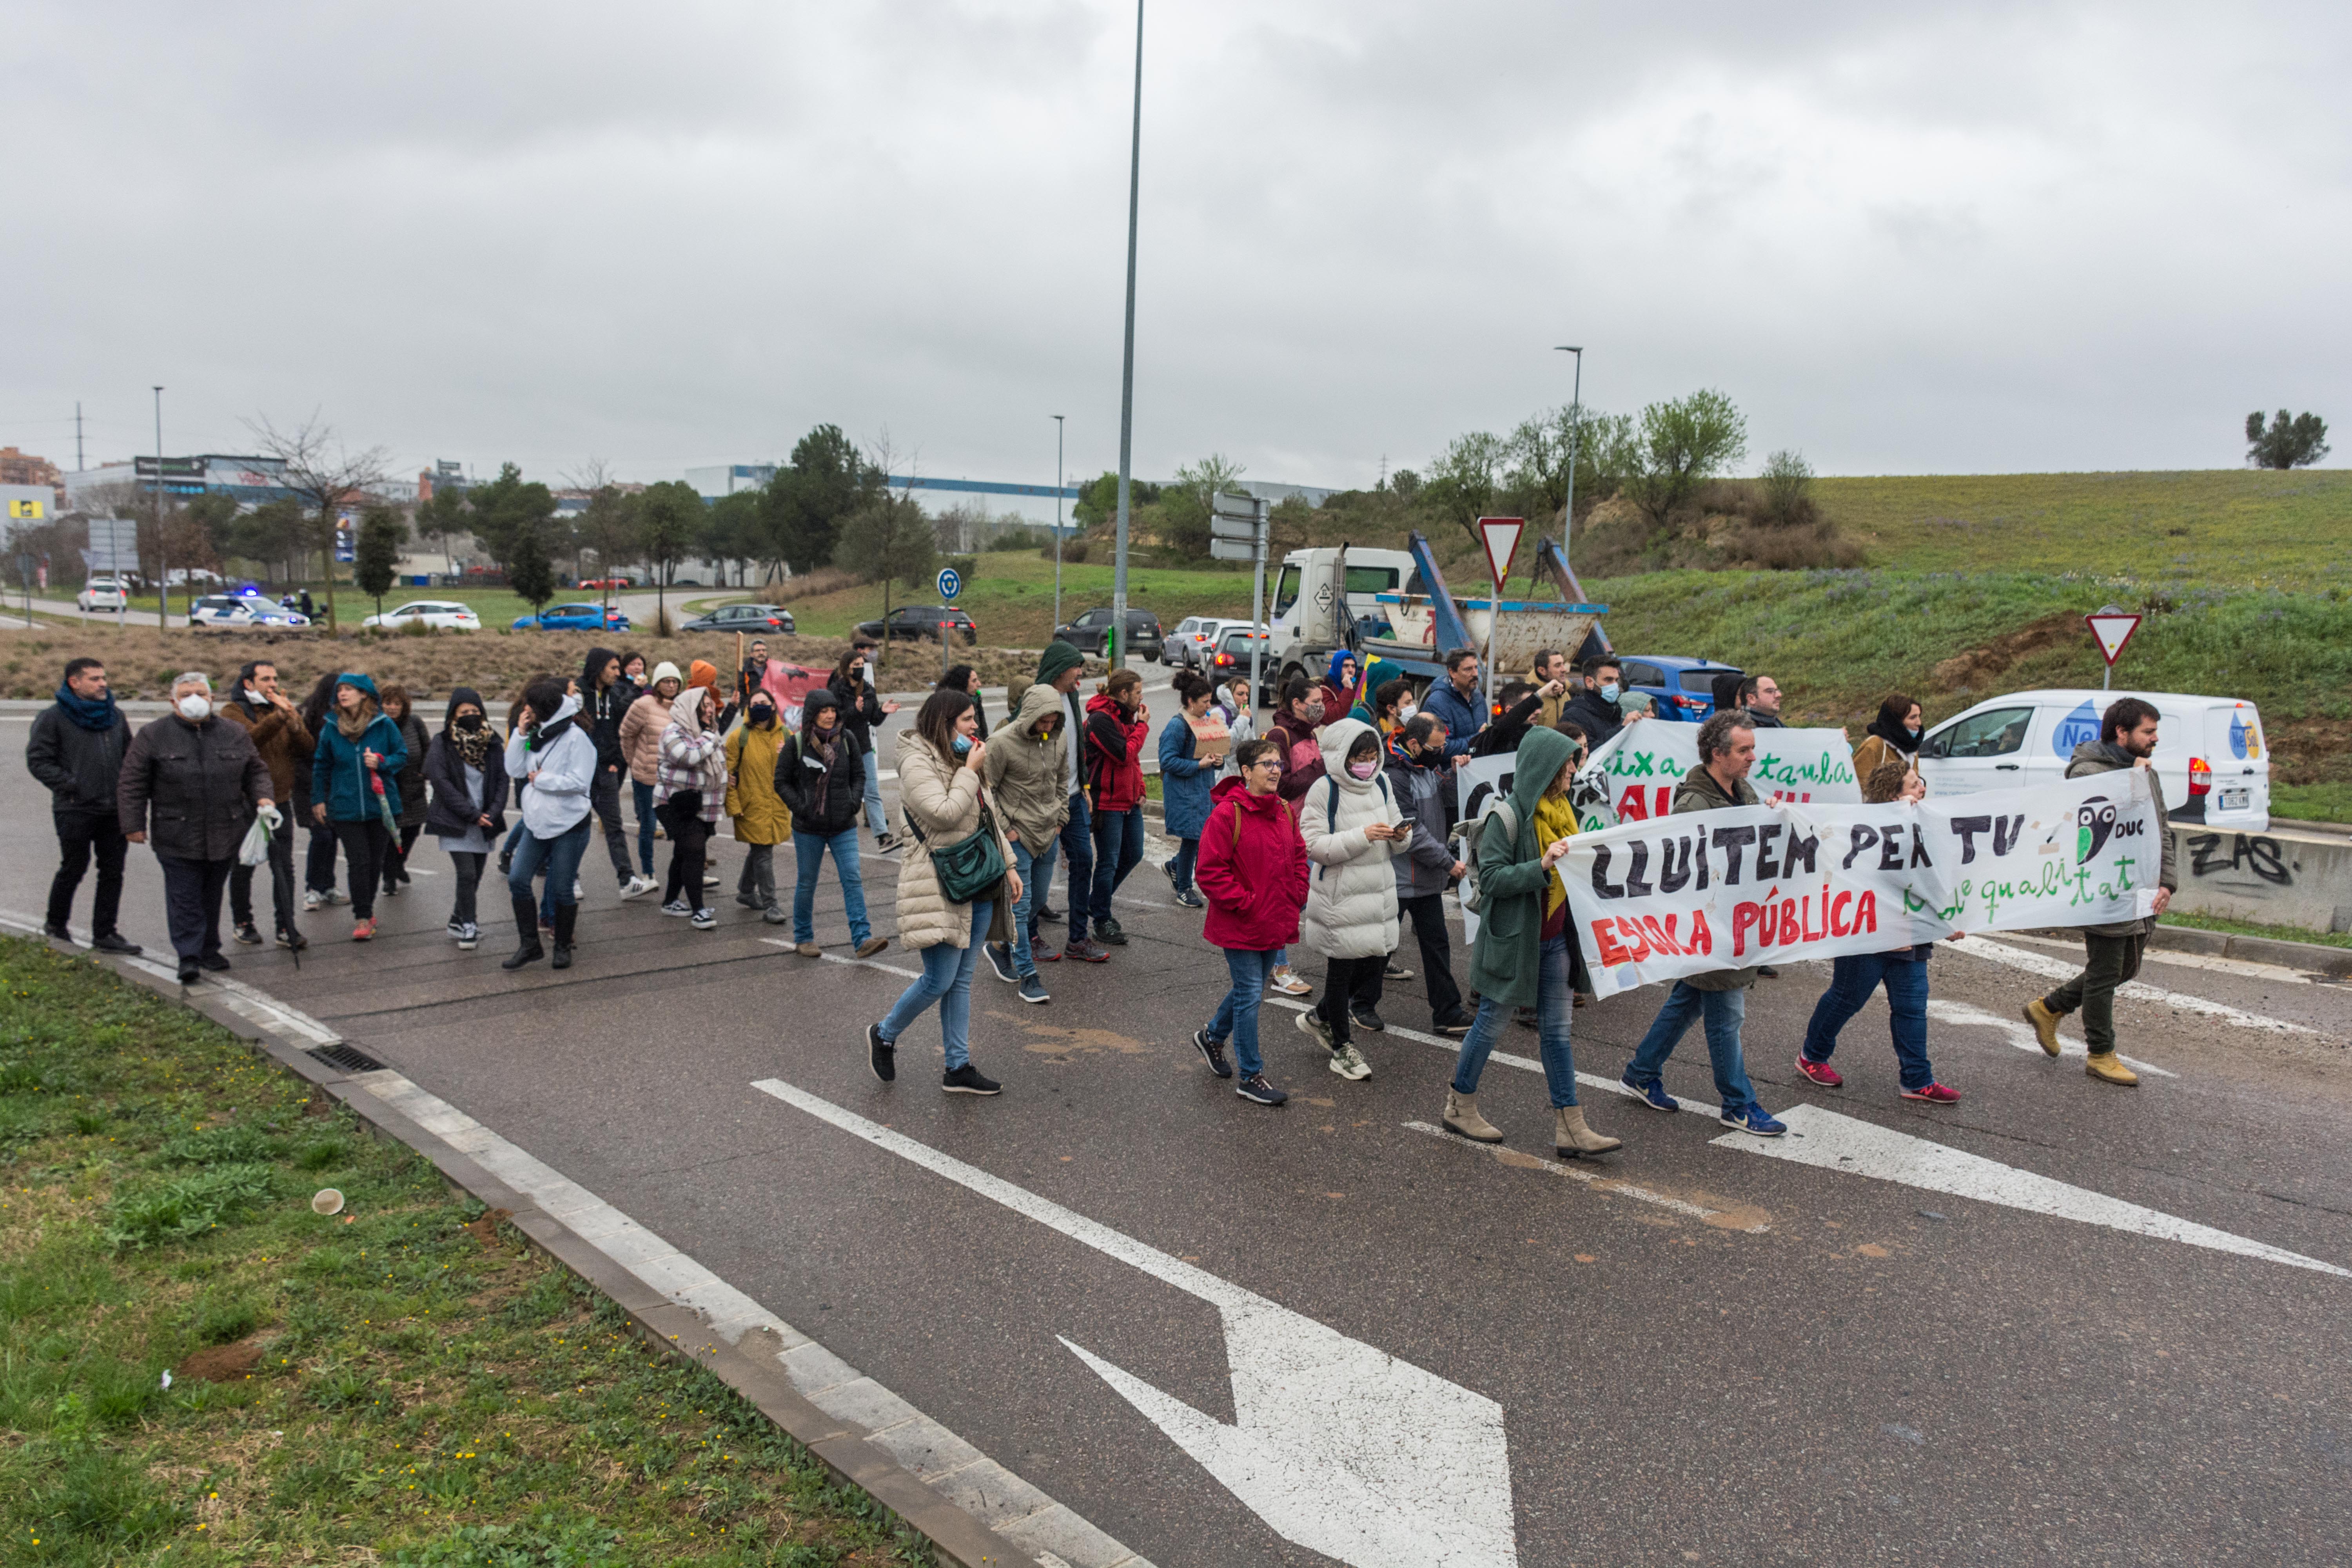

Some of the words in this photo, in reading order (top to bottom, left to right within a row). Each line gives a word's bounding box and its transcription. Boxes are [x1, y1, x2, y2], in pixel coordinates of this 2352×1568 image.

[1754, 751, 1853, 787] taula
[1842, 823, 1933, 870] PER
[1950, 814, 2025, 865] TU
[2115, 819, 2143, 838] DUC
[1591, 909, 1712, 968] ESCOLA
[1981, 848, 2135, 924] qualitat
